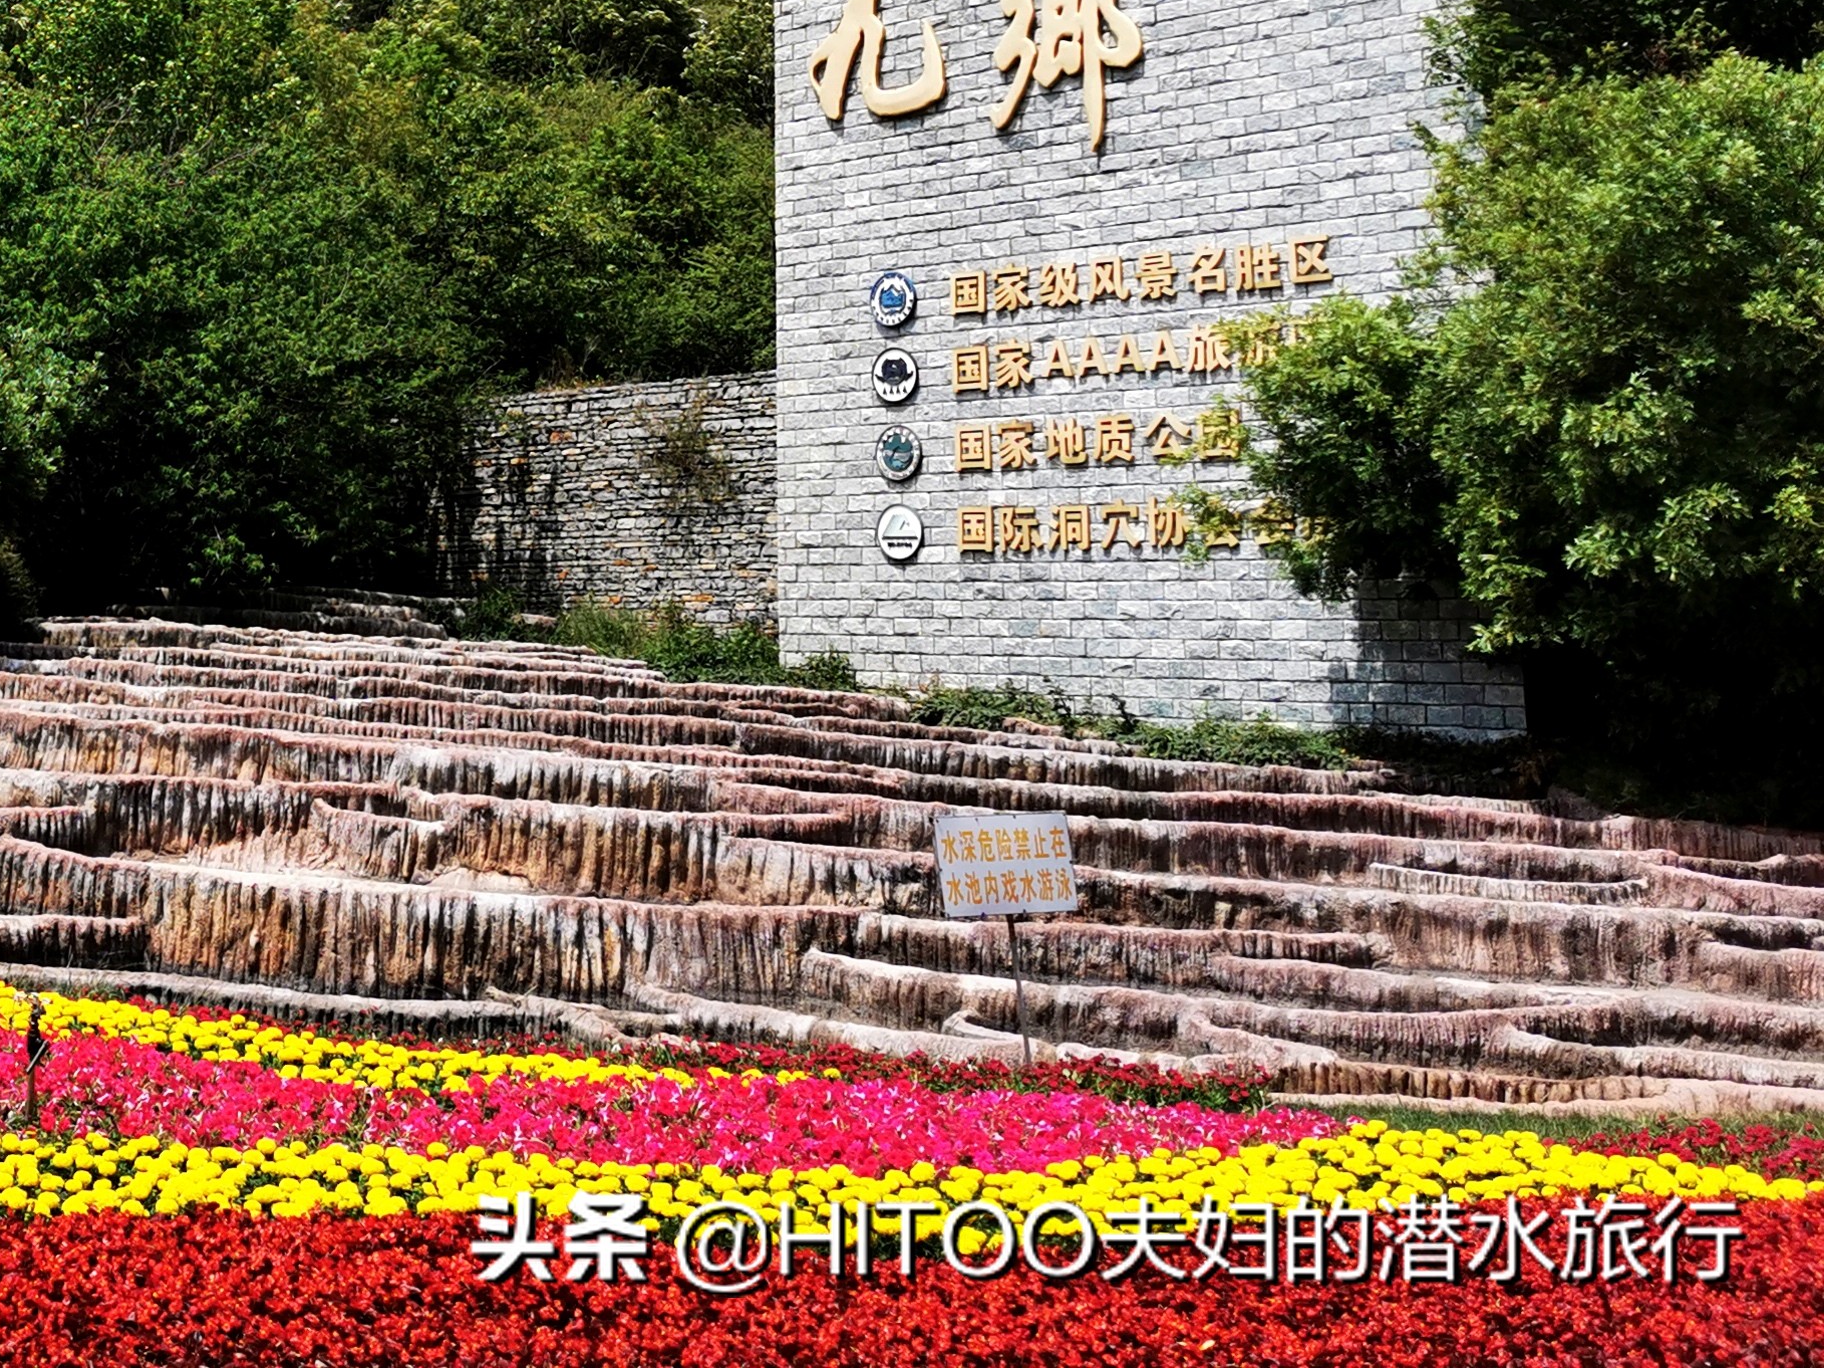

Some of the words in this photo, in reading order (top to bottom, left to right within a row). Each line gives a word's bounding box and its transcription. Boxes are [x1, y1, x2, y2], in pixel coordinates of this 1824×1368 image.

[949, 234, 1334, 316] 国家级风景名胜区
[941, 825, 1068, 864] 水深危险禁止在
[946, 867, 1073, 906] 水池内戏水游泳
